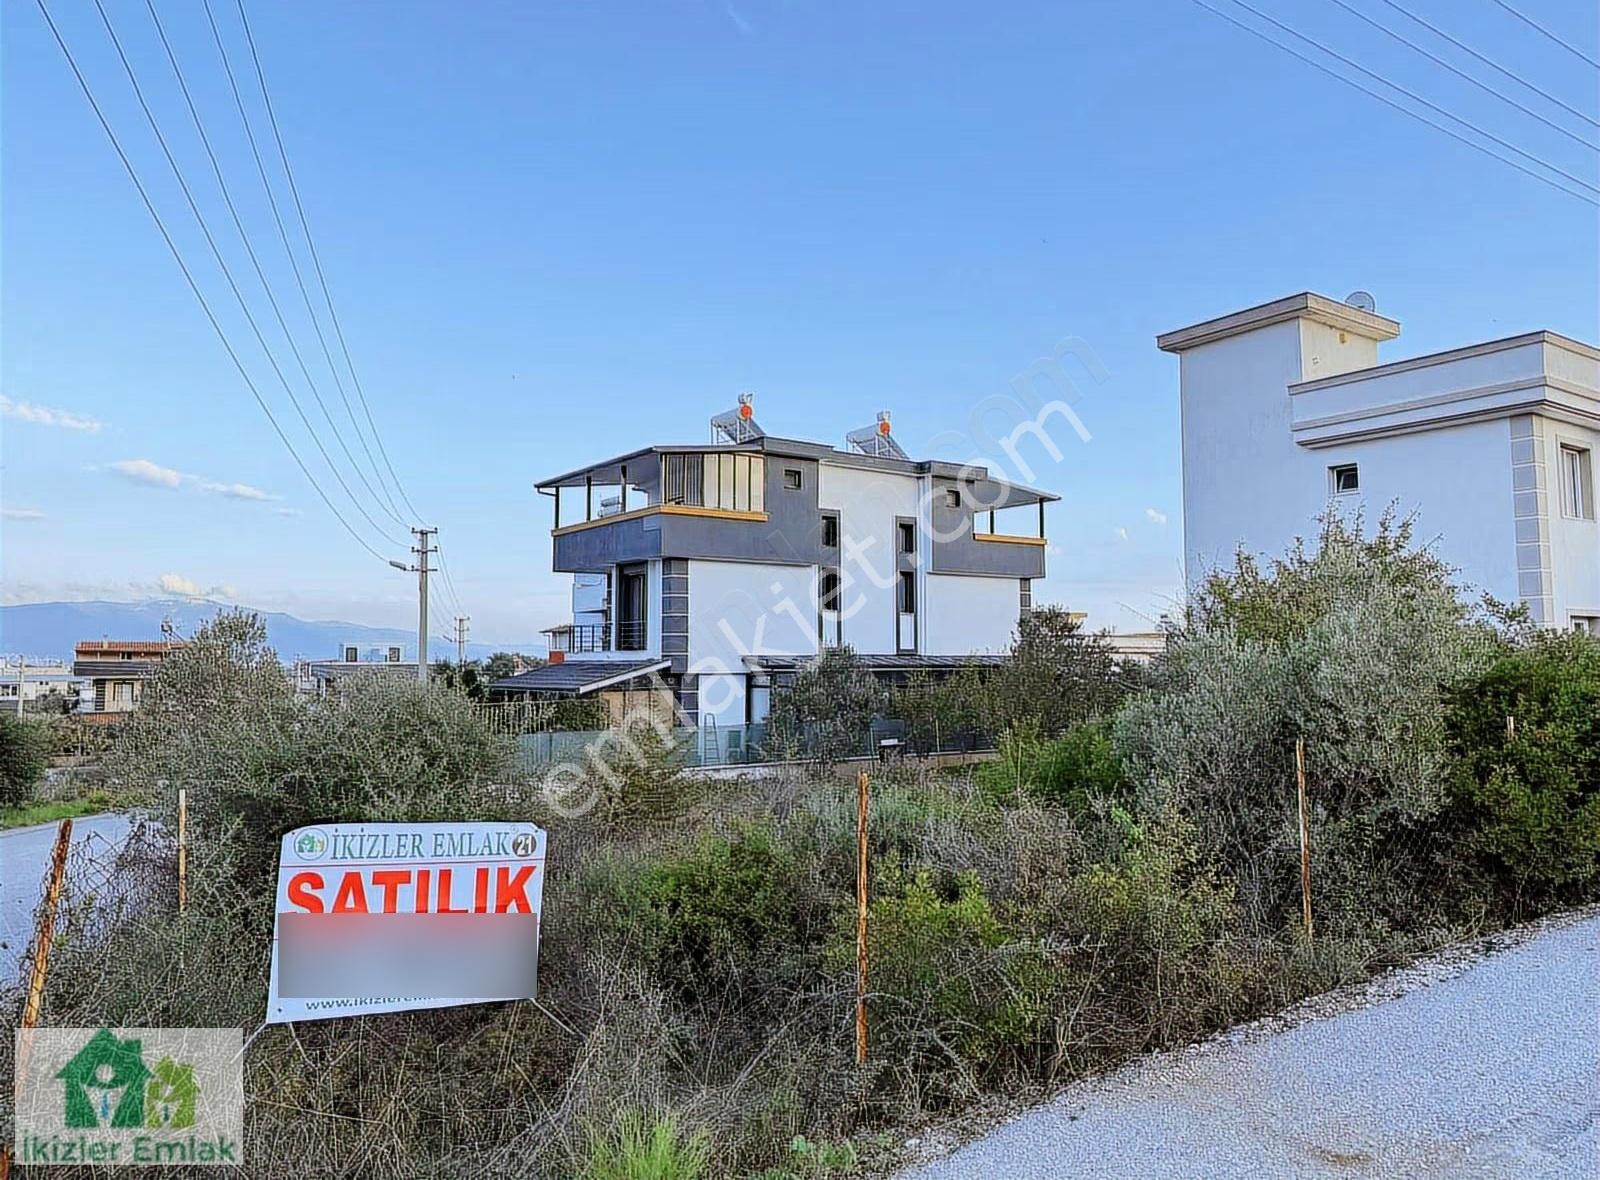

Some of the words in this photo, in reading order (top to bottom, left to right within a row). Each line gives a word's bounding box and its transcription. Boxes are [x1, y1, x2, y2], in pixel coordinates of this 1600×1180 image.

[330, 827, 425, 860] İKİZLER
[430, 831, 510, 857] EMLAK
[516, 834, 533, 855] 21
[287, 865, 537, 913] SATILIK
